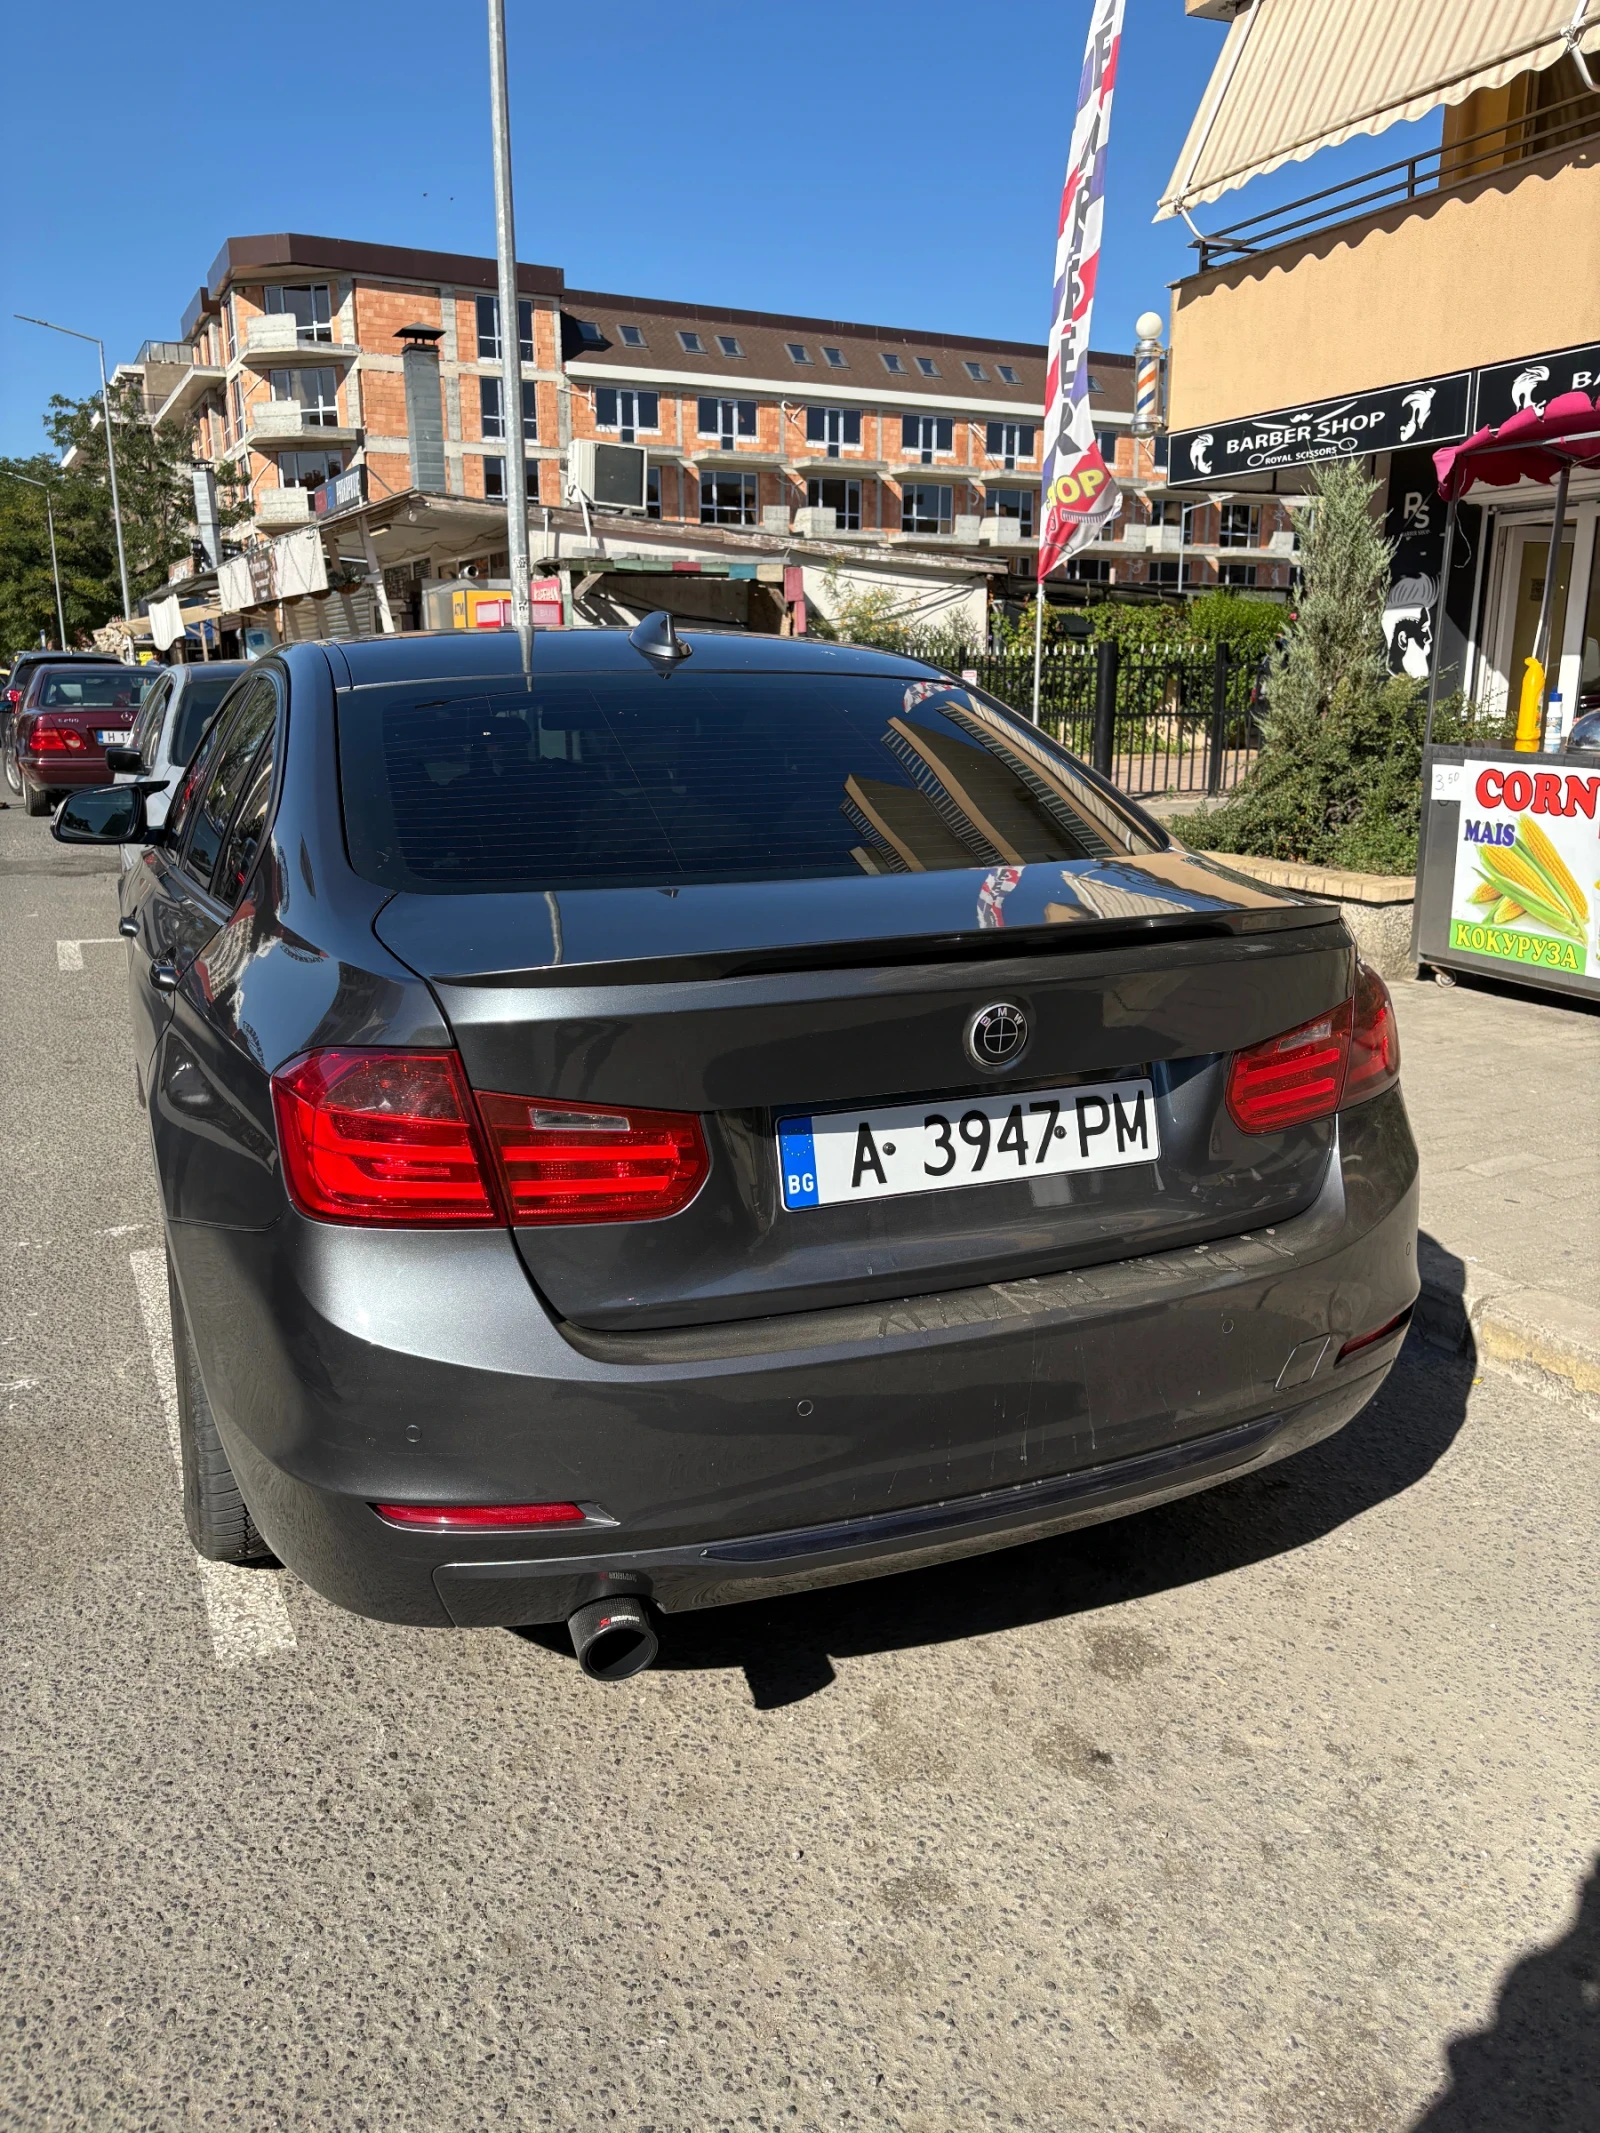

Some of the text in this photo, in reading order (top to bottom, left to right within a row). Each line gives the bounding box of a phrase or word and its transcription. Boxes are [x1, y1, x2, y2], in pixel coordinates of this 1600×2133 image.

[1226, 411, 1386, 454] BARBER SHOP
[1265, 446, 1337, 465] ROYAL SCISSORS
[1475, 768, 1600, 819] CORN
[1464, 819, 1516, 847] MAIS
[1456, 923, 1578, 969] КОКУРУЗА
[980, 1007, 1024, 1028] BMW
[787, 1089, 1150, 1195] BG A 3947 PM
